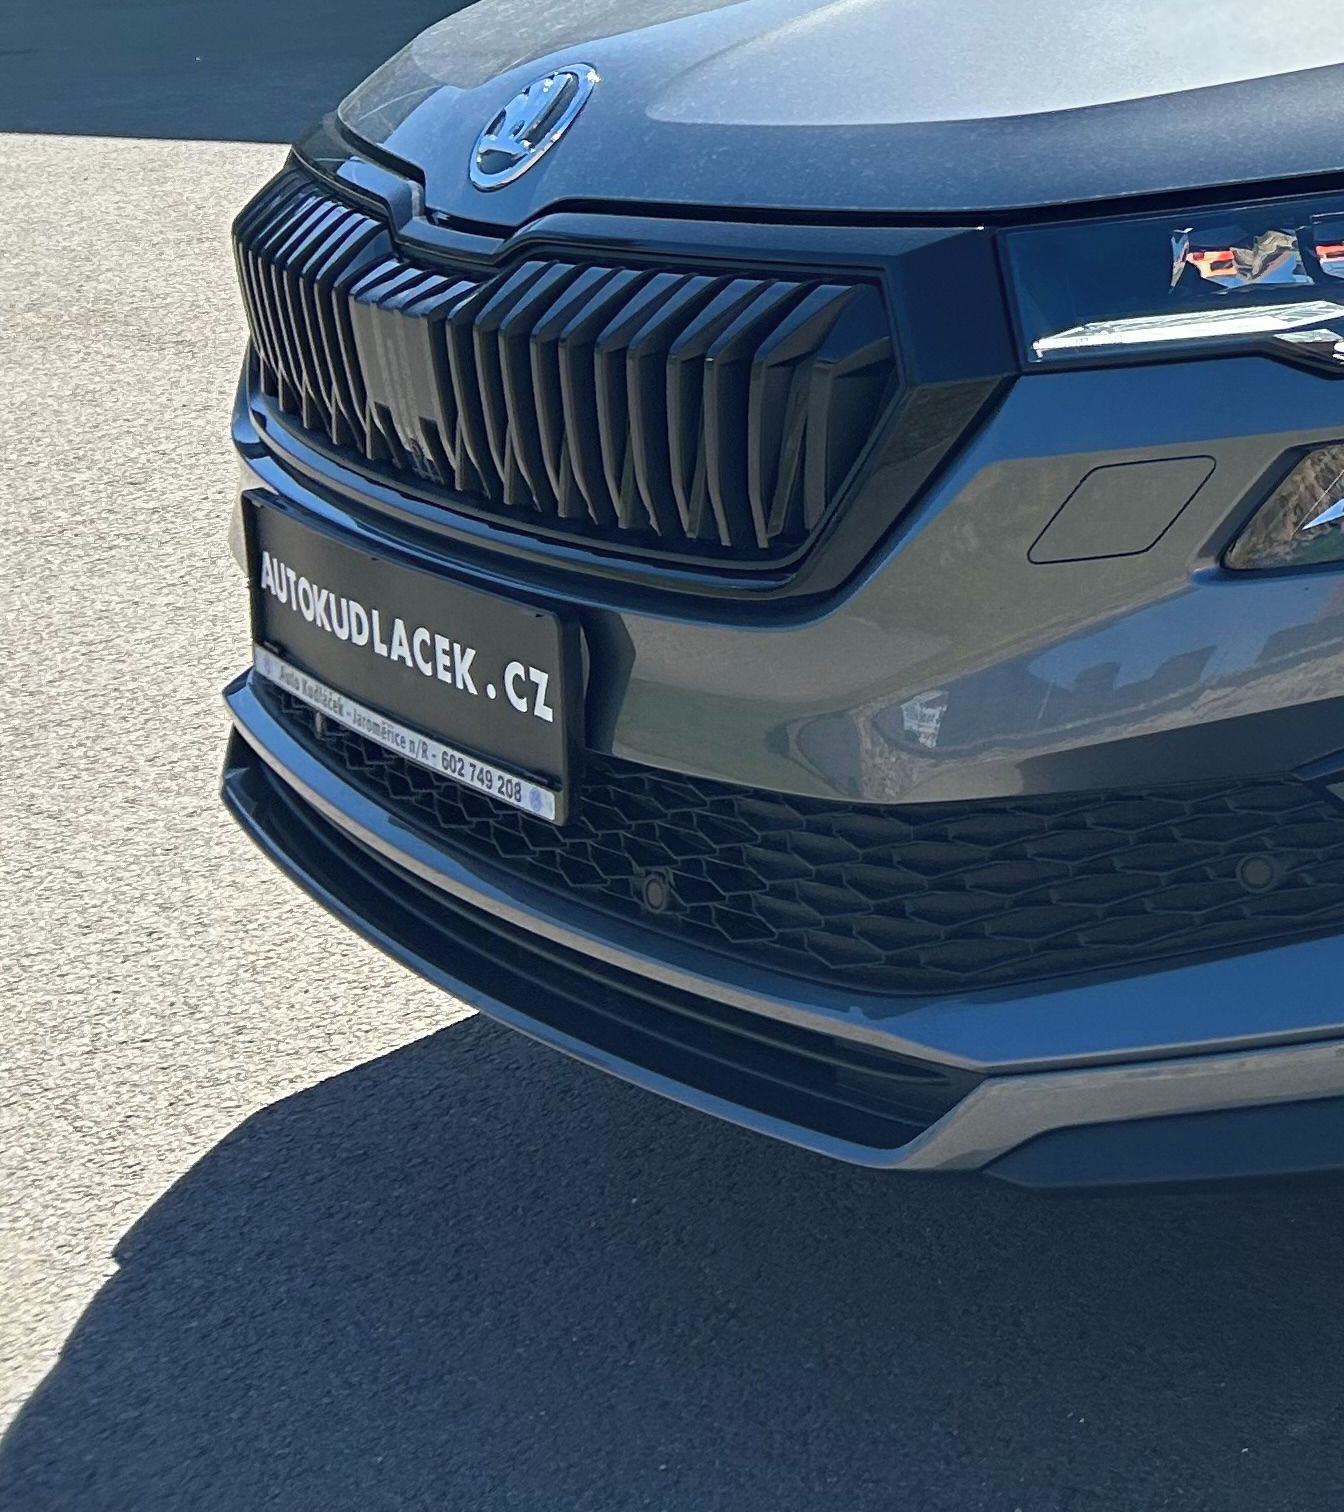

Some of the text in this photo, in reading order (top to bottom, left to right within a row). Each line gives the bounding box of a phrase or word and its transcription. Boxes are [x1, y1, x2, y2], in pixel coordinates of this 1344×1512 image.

[441, 750, 465, 778] 602
[469, 763, 493, 790] 749
[497, 775, 522, 803] 208
